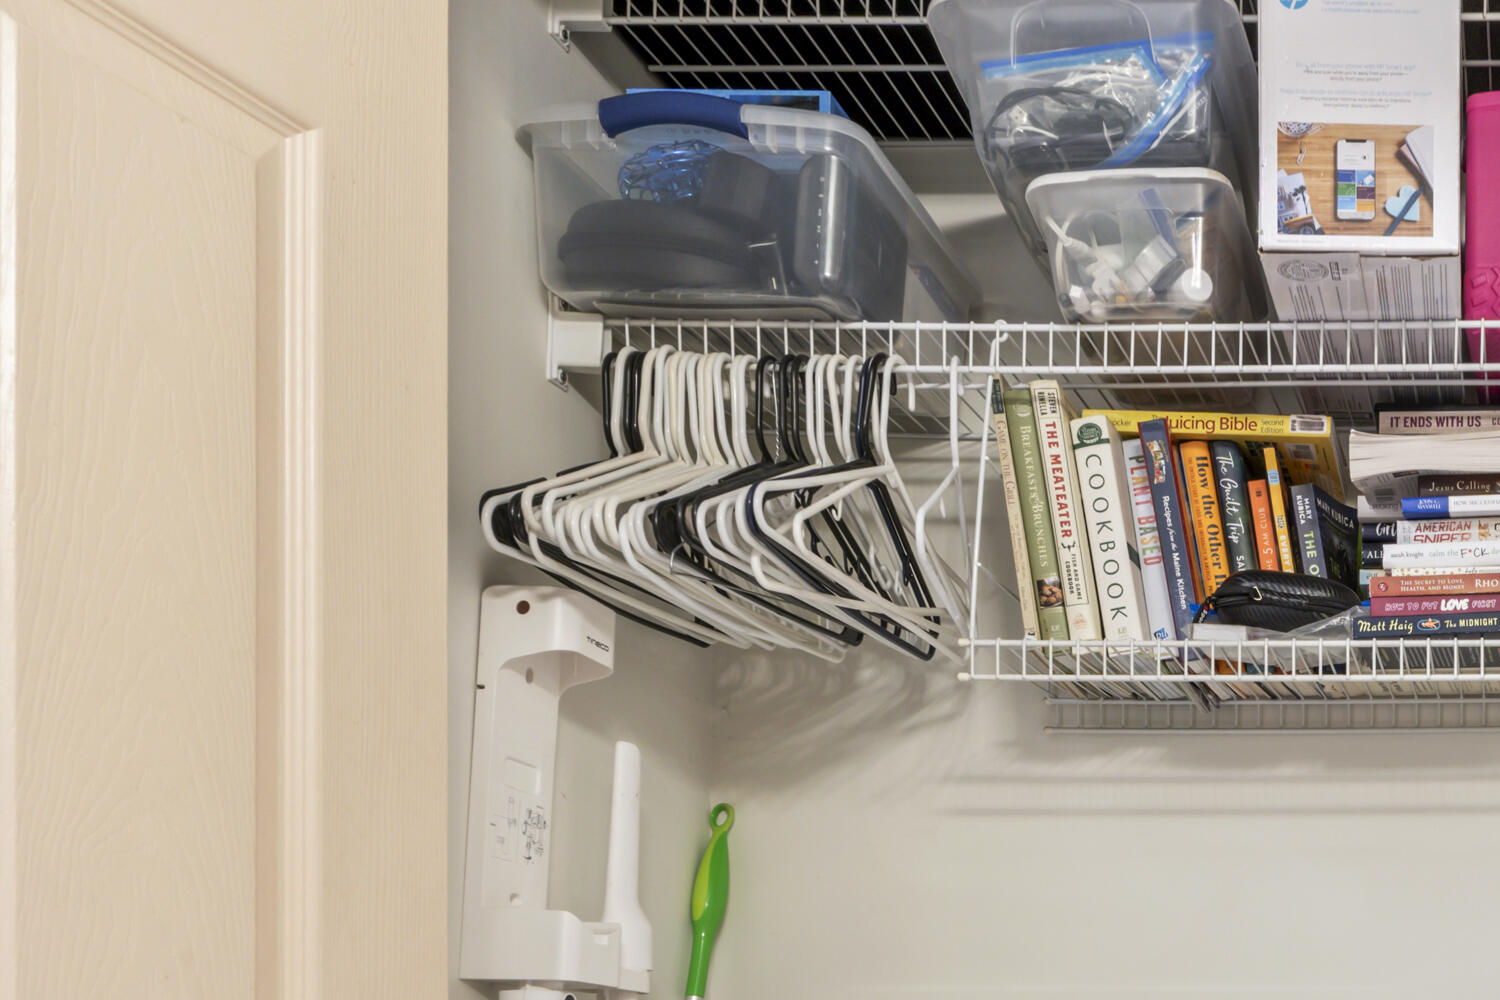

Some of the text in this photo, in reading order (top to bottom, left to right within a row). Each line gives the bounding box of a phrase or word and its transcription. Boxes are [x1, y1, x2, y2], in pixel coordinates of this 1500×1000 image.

[1037, 391, 1048, 416] RINELLA
[1047, 391, 1057, 414] STEVEN
[1219, 417, 1258, 431] Bible
[1260, 418, 1284, 427] Second
[1260, 426, 1284, 434] Edition
[1390, 415, 1482, 428] IT ENDS WITH US
[1195, 455, 1211, 491] How
[1216, 451, 1234, 475] The
[1045, 421, 1073, 538] THE MEATEATER
[1428, 480, 1491, 493] Jesus Calling
[1019, 425, 1038, 498] BREAKFASTS
[1031, 506, 1049, 567] BRUNCHES
[1202, 494, 1216, 519] the
[1219, 477, 1241, 516] Guilt
[1303, 497, 1312, 520] MARY
[1129, 455, 1162, 566] PLANT BASED
[1161, 495, 1173, 528] Recipes
[1295, 495, 1306, 525] KUBICA
[1085, 453, 1128, 620] COOKBOOK
[1226, 517, 1245, 544] Trip
[1415, 521, 1472, 533] AMERICAN
[1207, 523, 1223, 570] Other
[1262, 547, 1273, 555] 5
[1303, 530, 1317, 558] THE
[1172, 552, 1182, 577] Maine
[1065, 560, 1074, 595] COOKBOOK
[1176, 578, 1187, 610] Kitchen
[1440, 599, 1470, 611] LOVE
[1357, 618, 1414, 633] Matt Haig
[1443, 619, 1457, 628] The
[1459, 617, 1498, 627] MIDNIGHT
